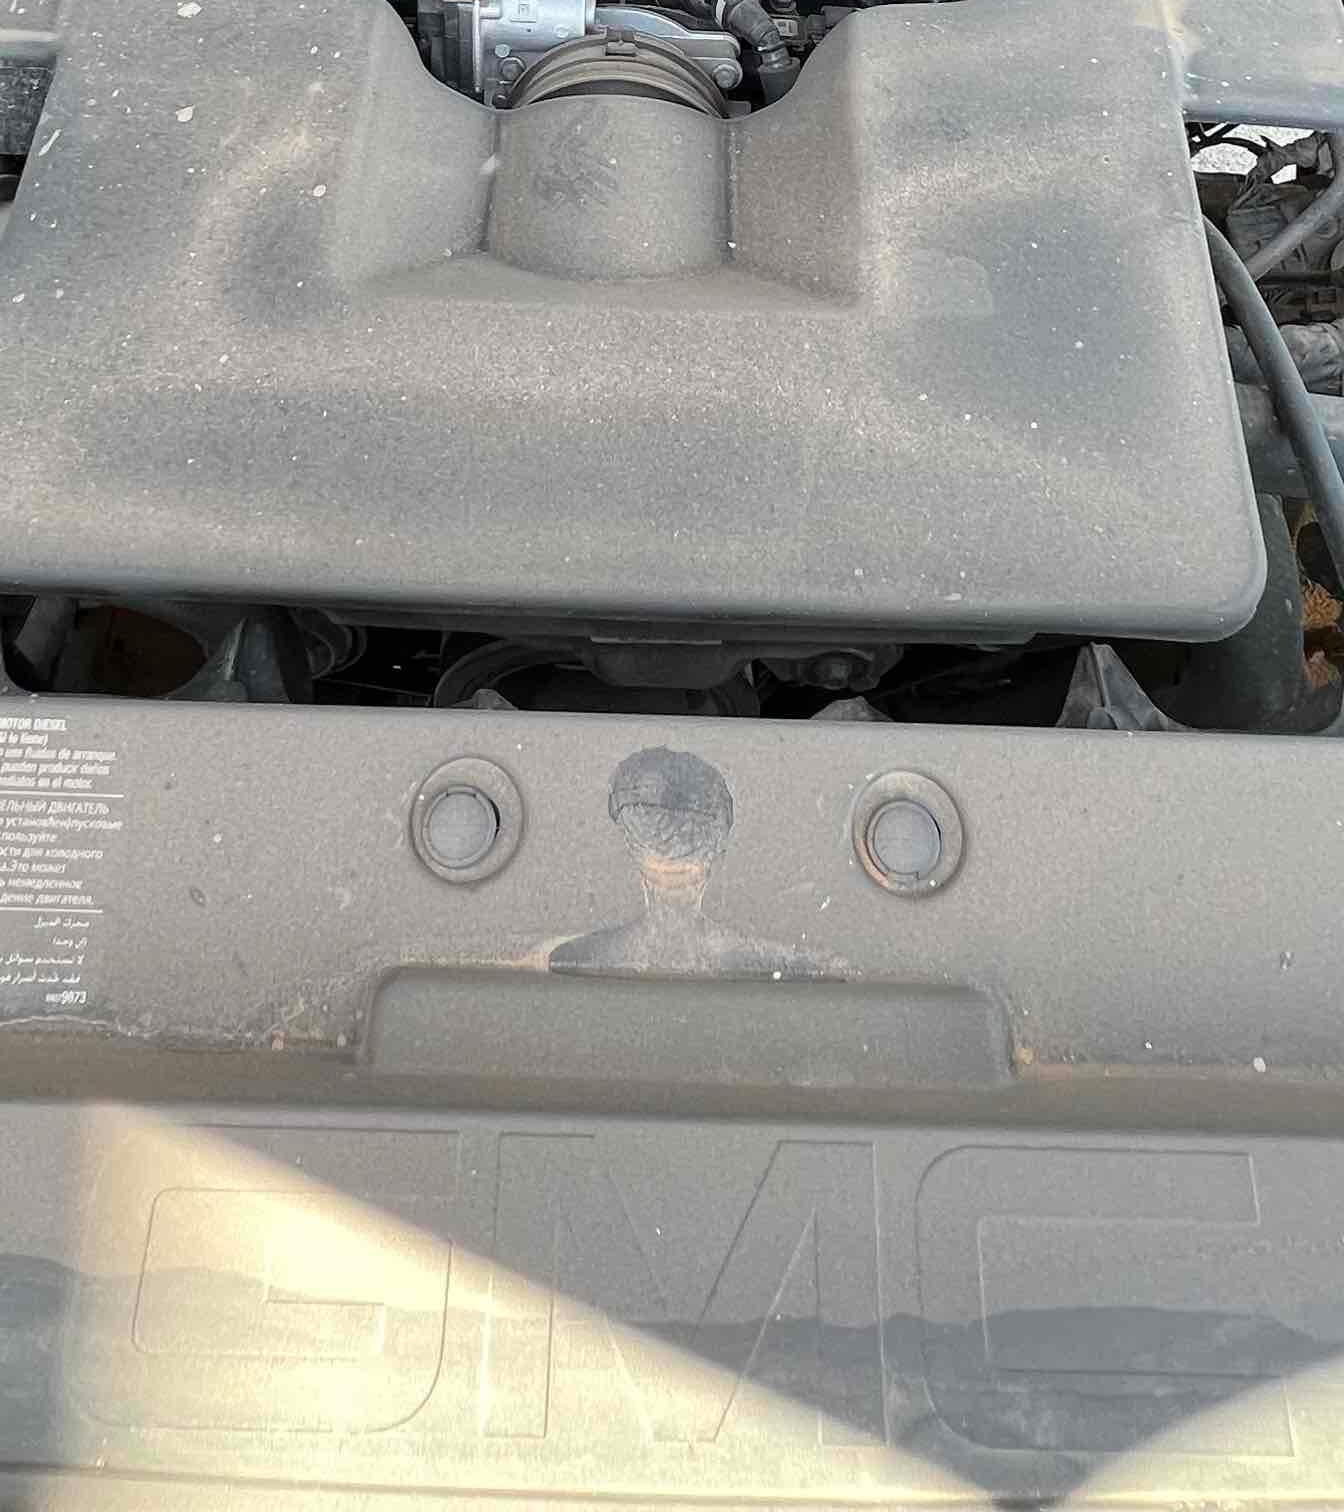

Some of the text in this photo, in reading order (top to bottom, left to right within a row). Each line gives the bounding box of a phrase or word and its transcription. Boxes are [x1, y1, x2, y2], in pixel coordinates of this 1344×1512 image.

[33, 718, 67, 730] DIESEL
[47, 800, 109, 815] ДВИГАТЕЛЬ
[90, 1123, 1297, 1459] GMC
